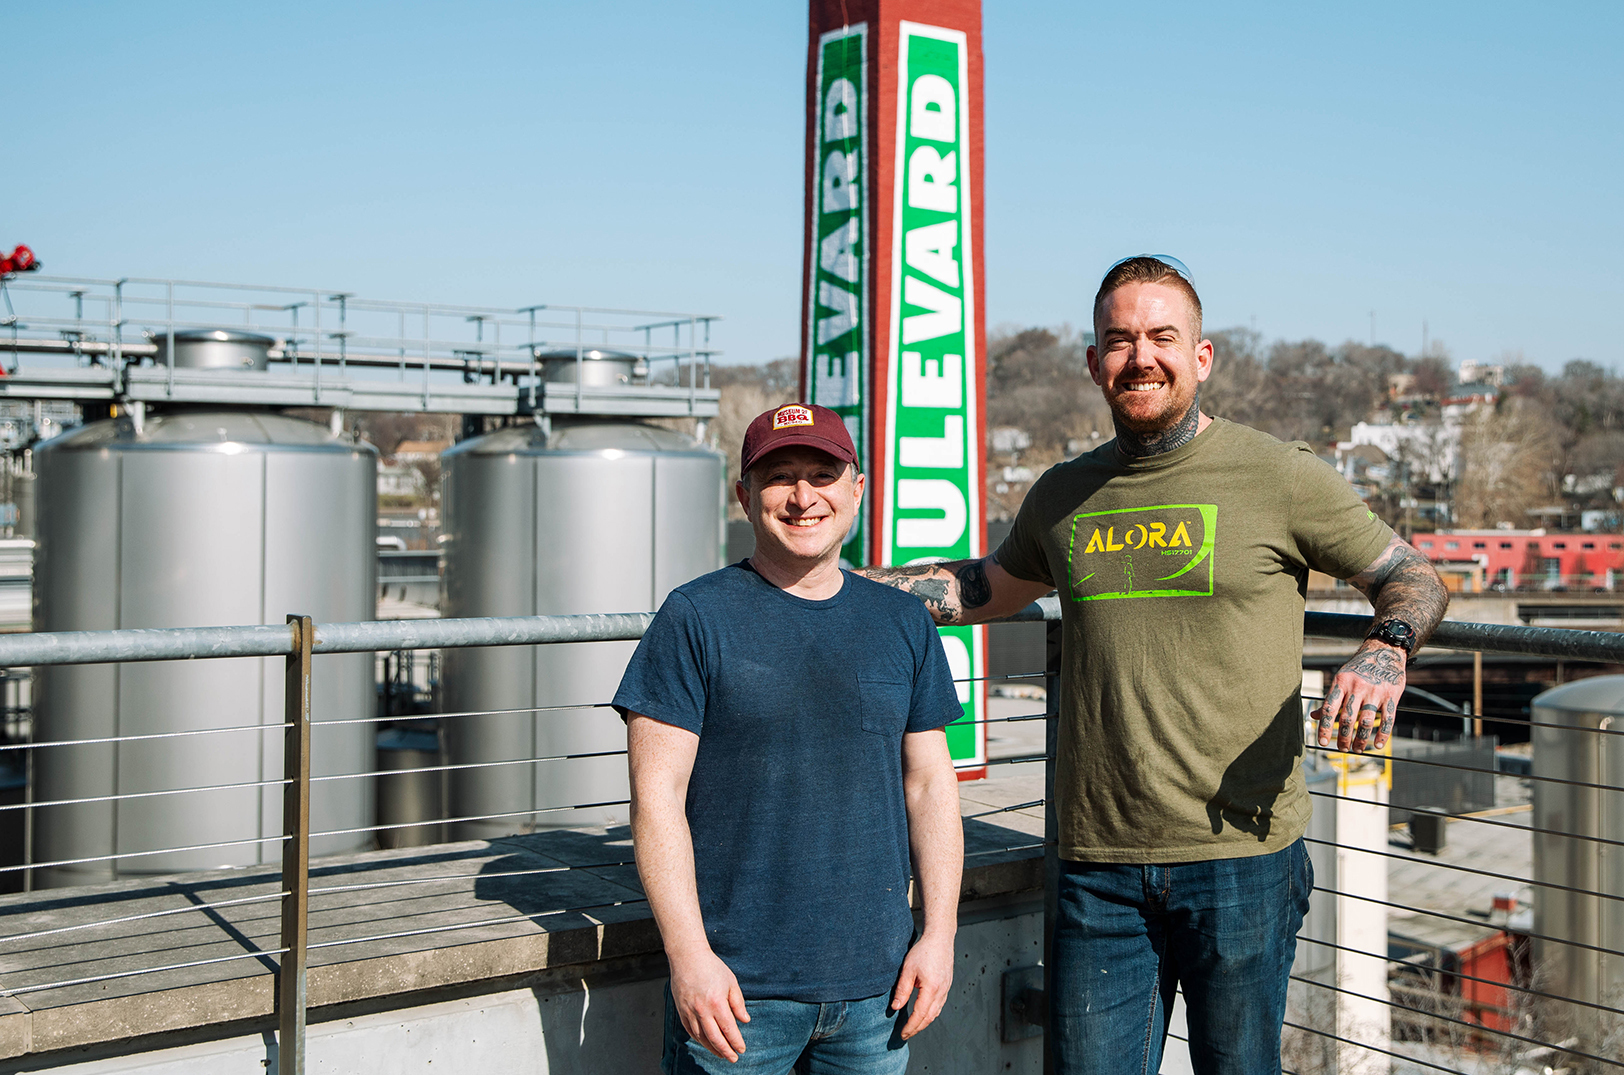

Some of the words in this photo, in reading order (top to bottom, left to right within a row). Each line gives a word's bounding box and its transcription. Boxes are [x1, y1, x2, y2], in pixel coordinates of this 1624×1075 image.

[896, 74, 971, 703] ULEVARD
[777, 414, 809, 424] BBQ
[1084, 521, 1192, 553] ALORA
